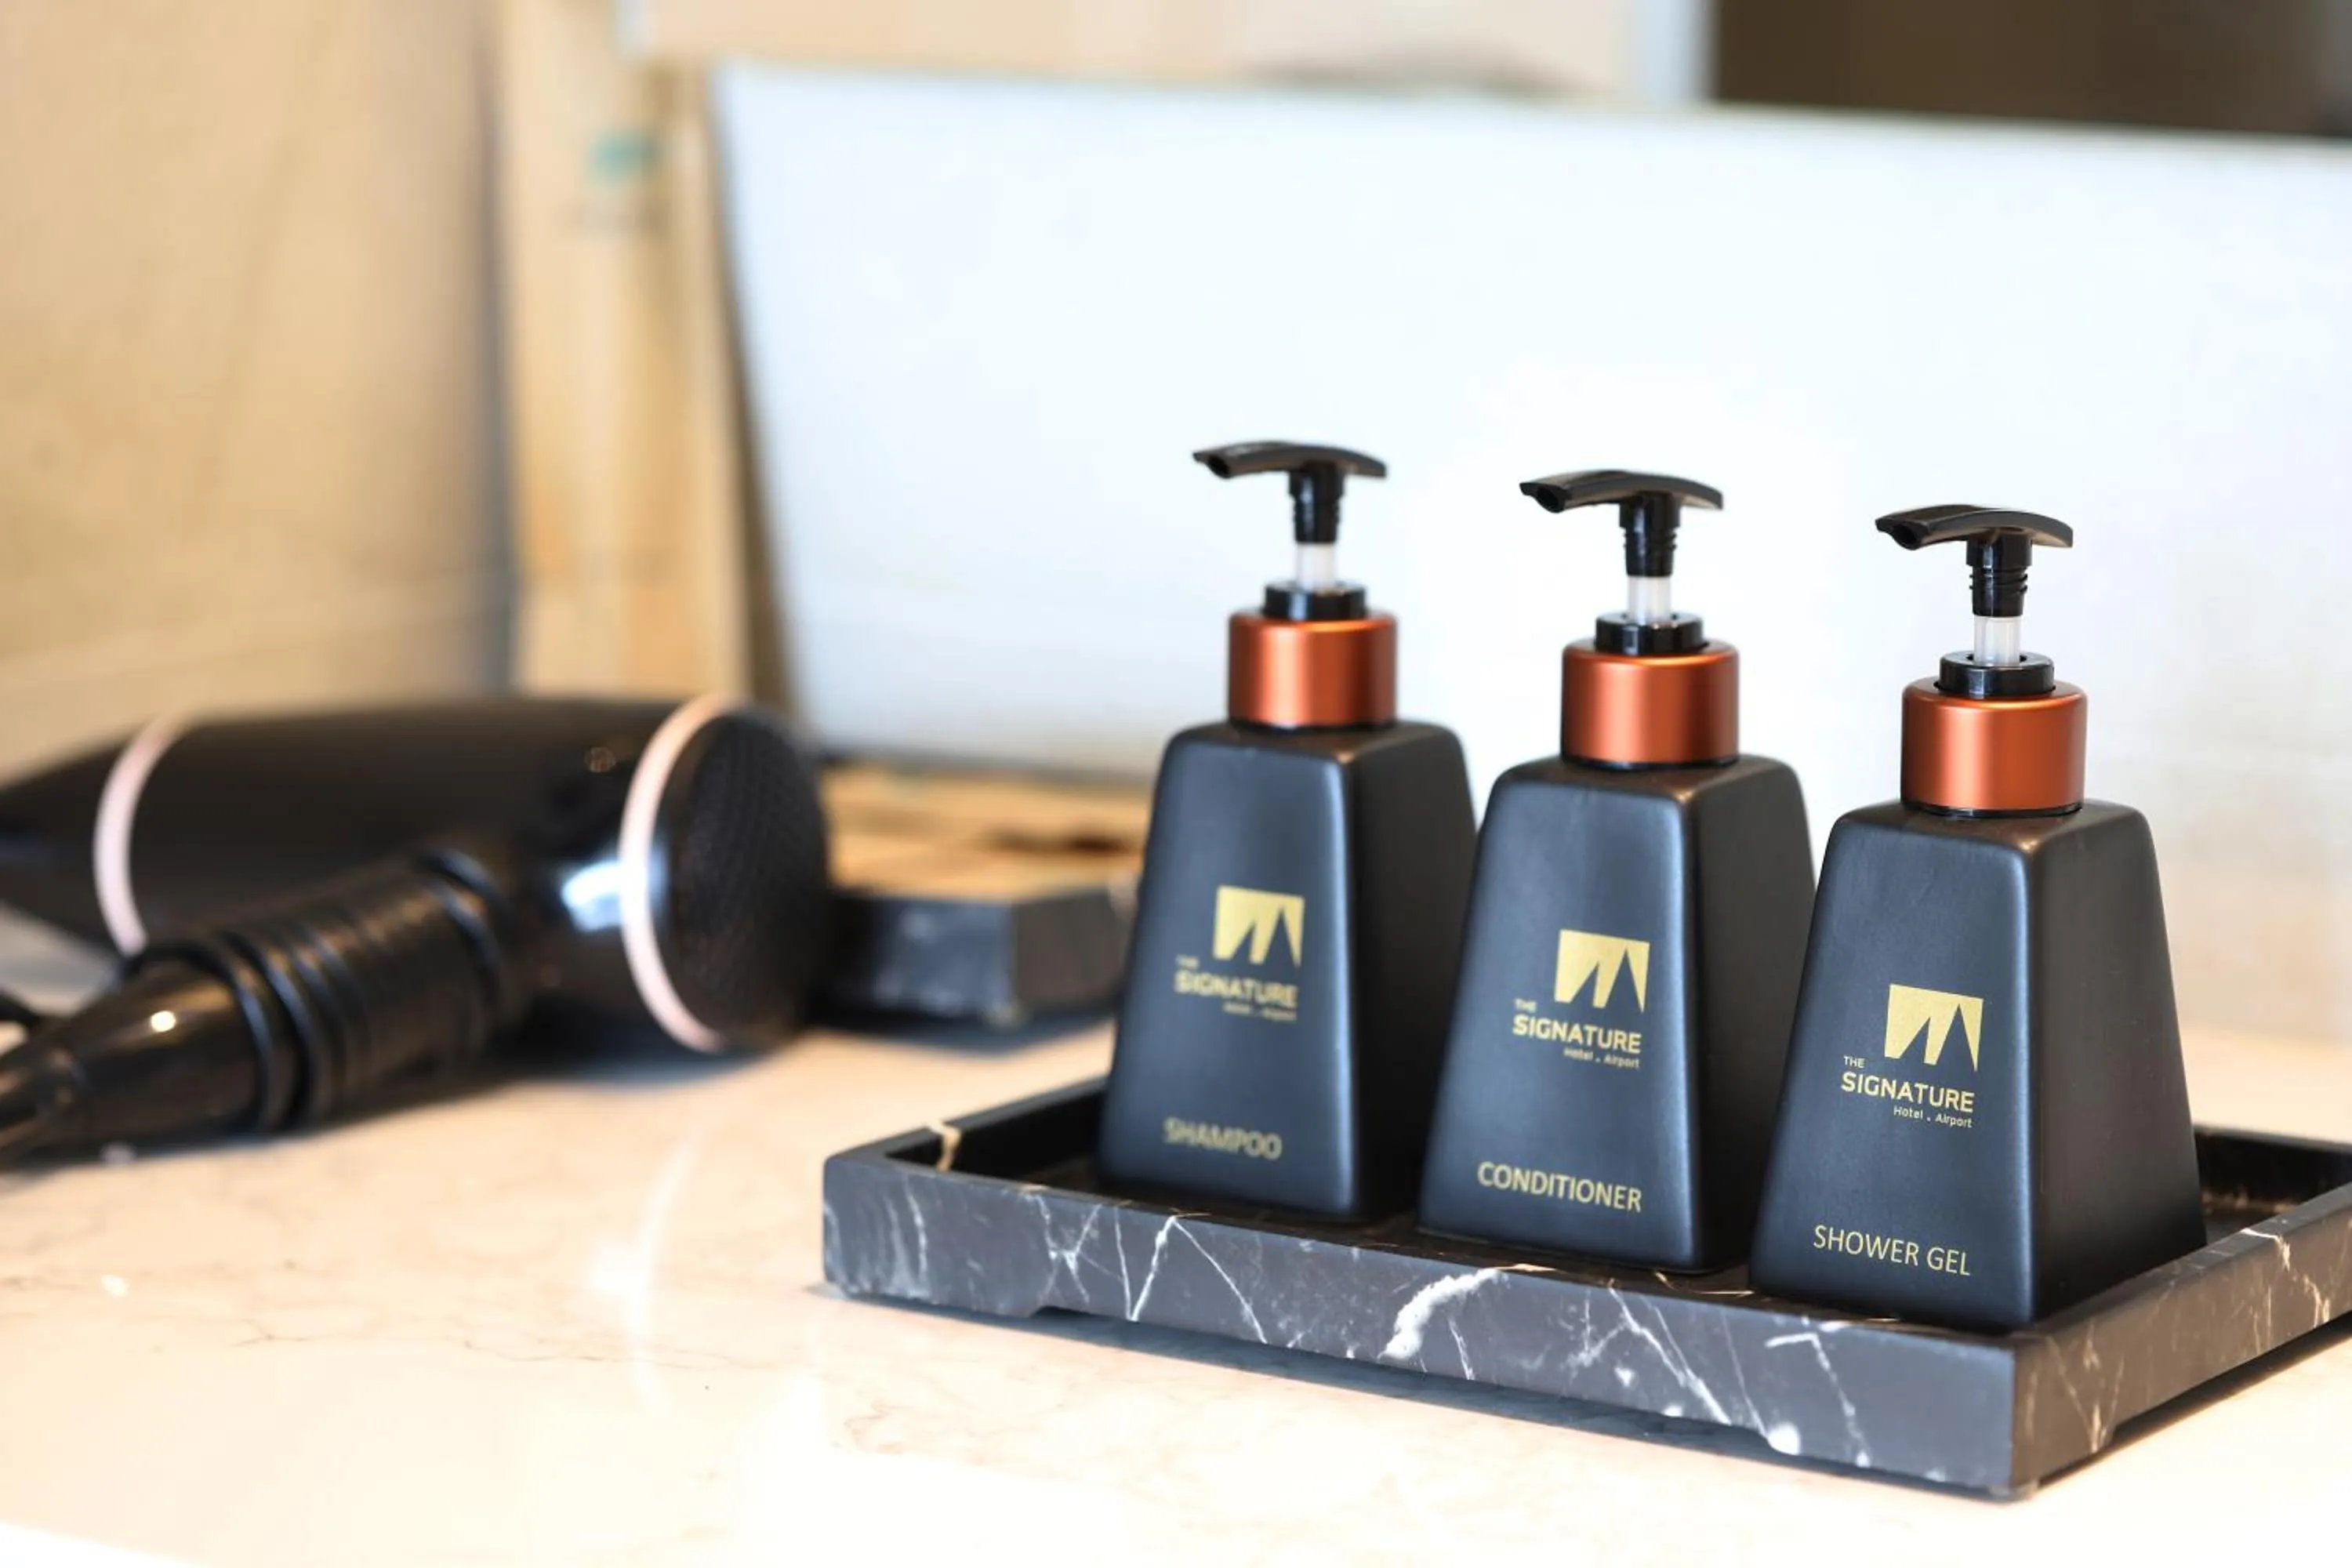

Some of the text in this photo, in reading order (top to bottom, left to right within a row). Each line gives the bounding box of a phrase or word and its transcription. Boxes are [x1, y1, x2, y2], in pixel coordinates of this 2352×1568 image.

[1174, 970, 1298, 1007] SIGNATURE
[1512, 1014, 1642, 1054] SIGNATURE
[1604, 1054, 1639, 1069] Airport
[1843, 1055, 1865, 1069] THE
[1841, 1071, 1975, 1113] SIGNATURE
[1893, 1105, 1923, 1120] Hotel
[1935, 1112, 1973, 1128] Airport
[1163, 1116, 1282, 1160] SHAMPOO
[1478, 1161, 1642, 1212] CONDITIONER
[1813, 1225, 1970, 1276] SHOWER GEL
